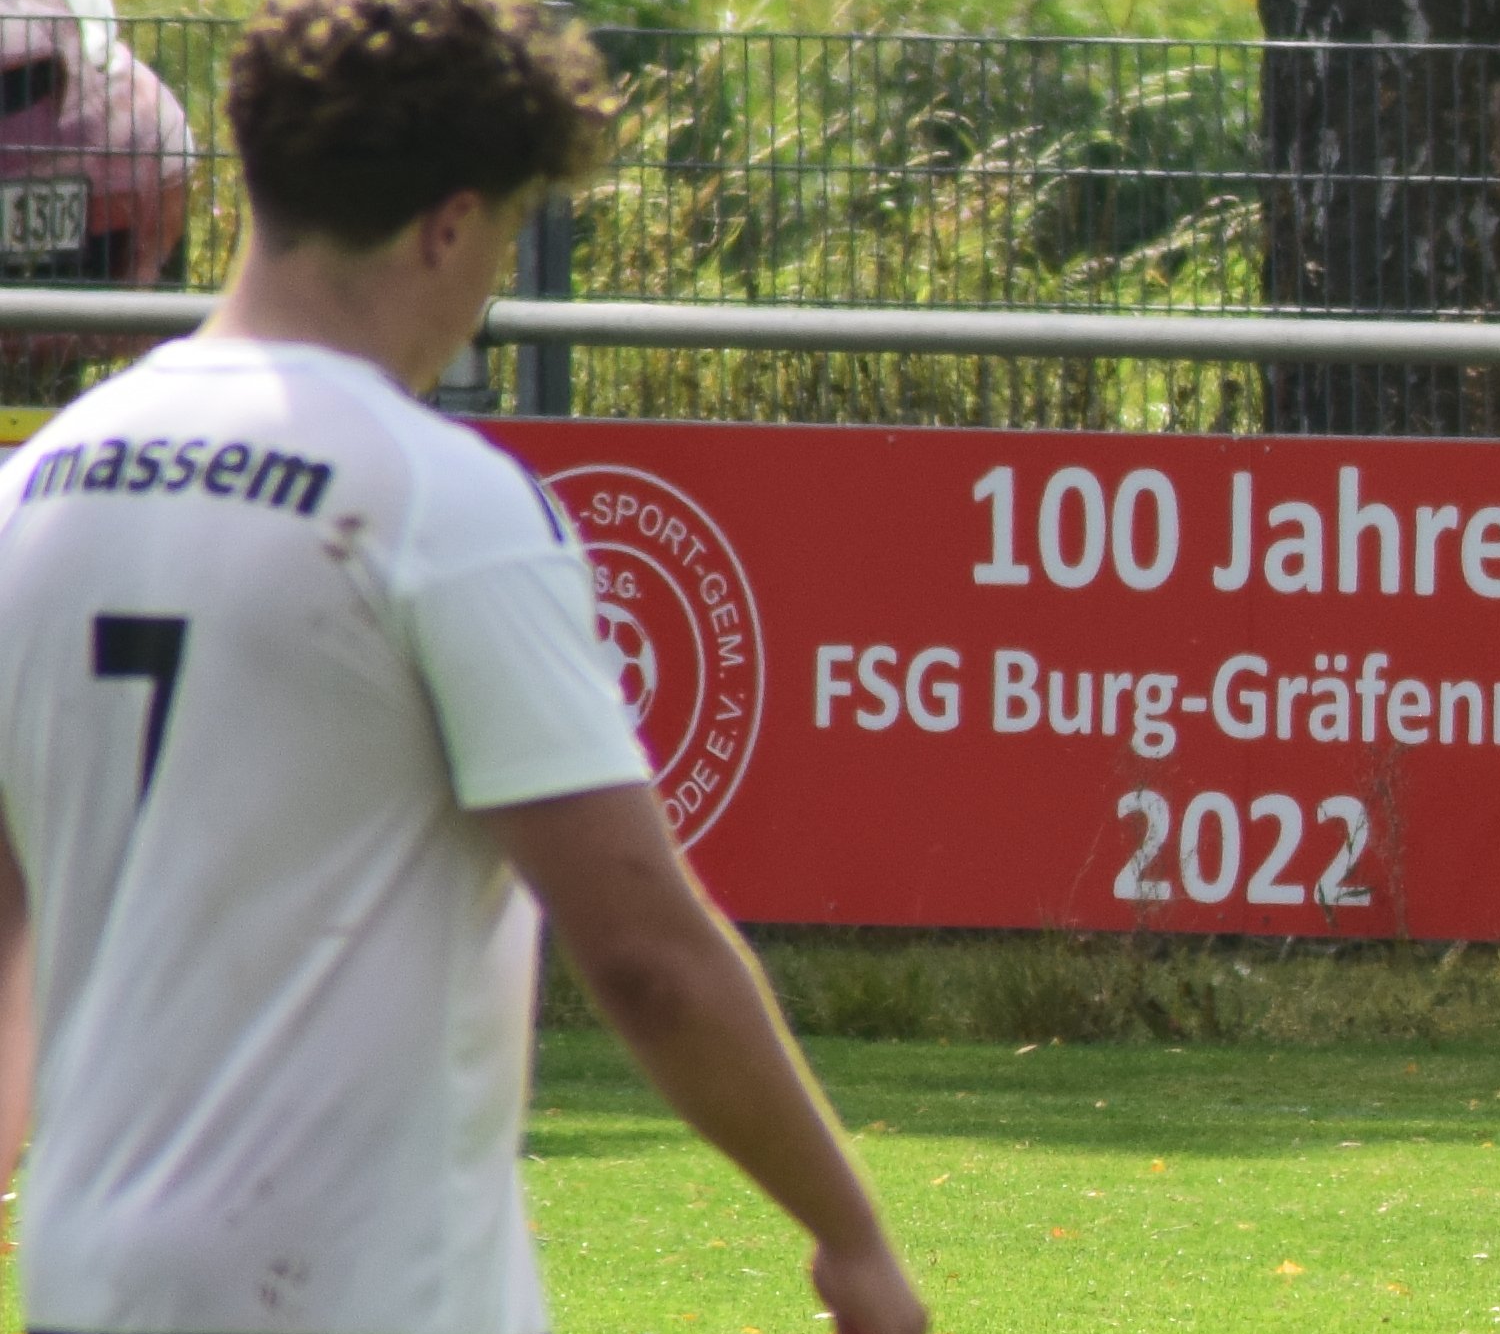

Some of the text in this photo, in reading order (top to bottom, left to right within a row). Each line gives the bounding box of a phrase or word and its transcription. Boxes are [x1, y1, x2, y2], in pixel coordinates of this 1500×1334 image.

[20, 437, 334, 517] massem
[971, 466, 1180, 590] 100
[91, 613, 190, 812] 7
[706, 691, 746, 762] E.V.
[815, 644, 961, 732] FSG
[1114, 790, 1371, 907] 2022
